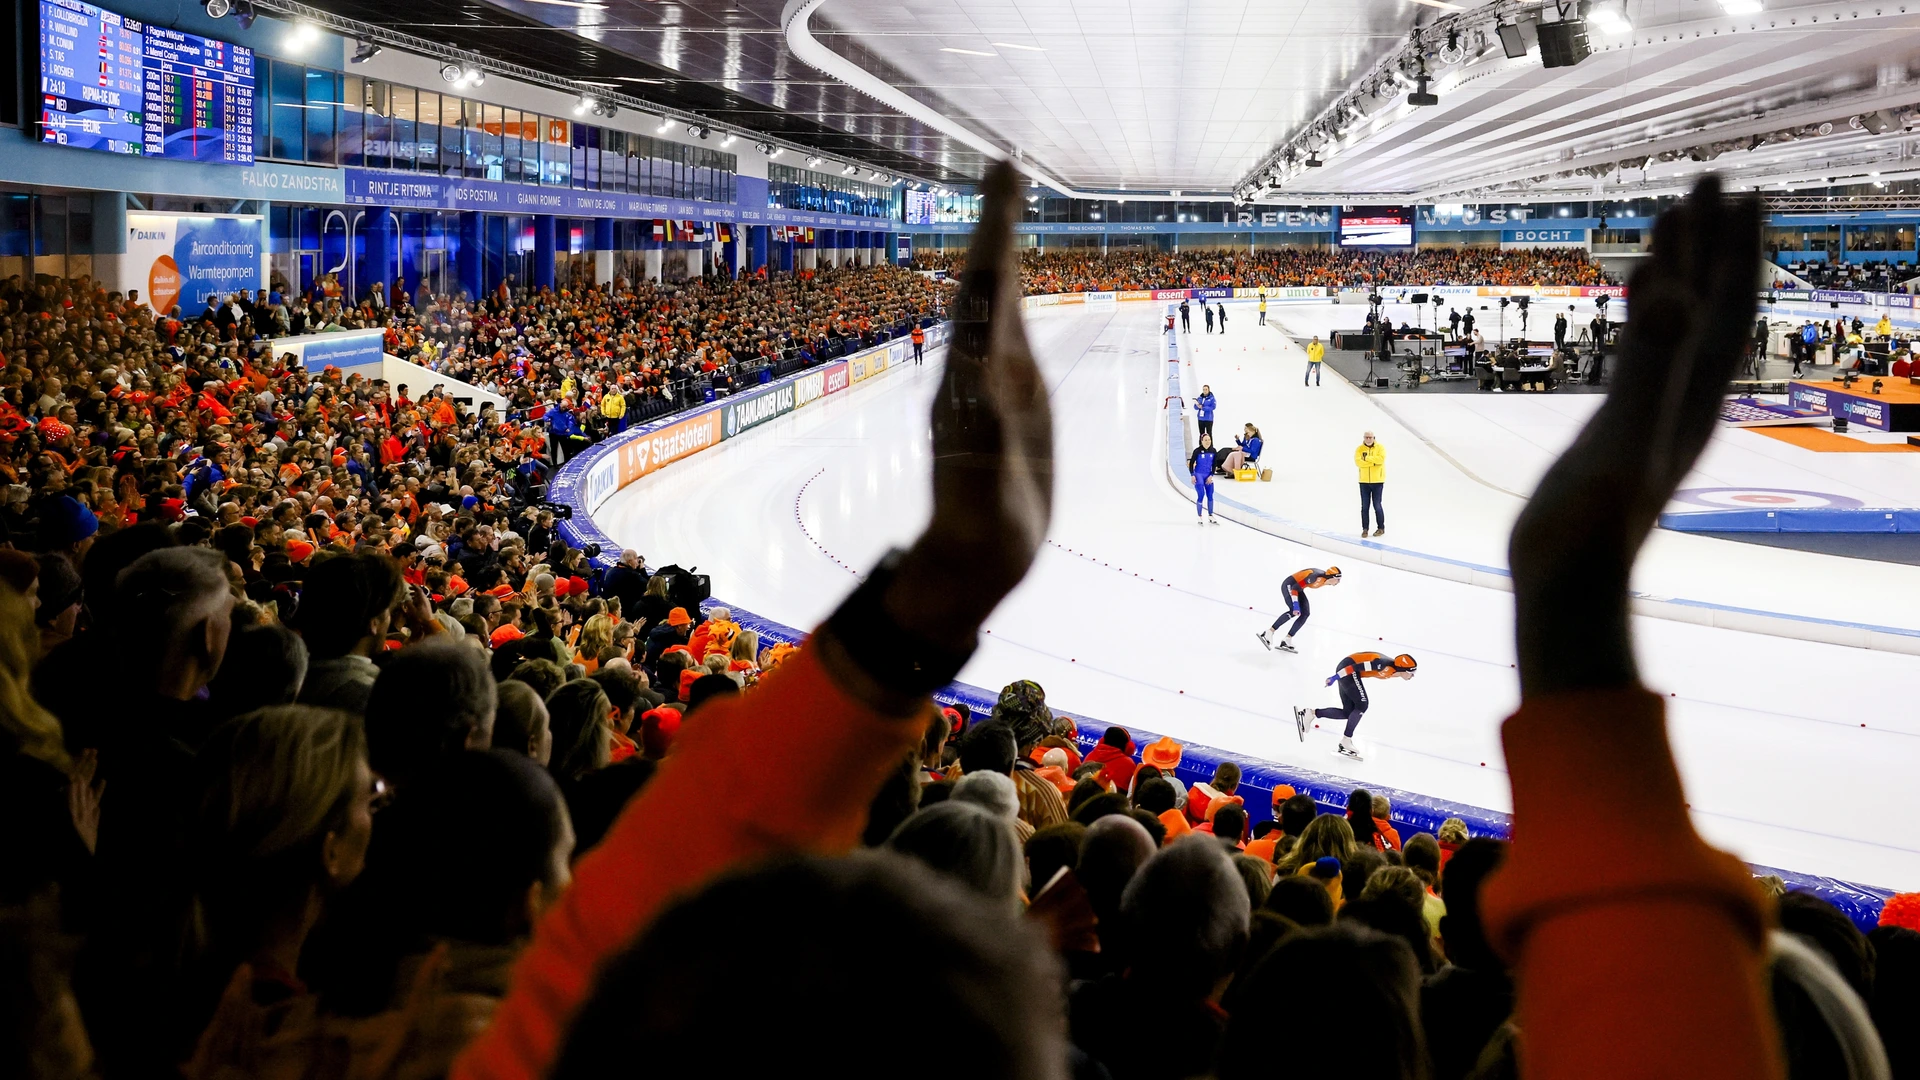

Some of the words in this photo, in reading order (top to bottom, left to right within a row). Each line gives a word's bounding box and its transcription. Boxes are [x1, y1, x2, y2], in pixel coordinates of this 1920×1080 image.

[149, 26, 165, 38] Ragne
[204, 39, 215, 48] NOR
[149, 37, 174, 50] Francesca
[204, 49, 212, 57] ITA
[54, 50, 65, 62] TAS
[204, 59, 215, 68] NED
[146, 71, 160, 81] 200m
[164, 74, 174, 83] 19.7
[146, 81, 160, 91] 600m
[164, 85, 174, 94] 30.0
[196, 90, 205, 98] 30.2
[56, 98, 67, 111] NED
[145, 92, 161, 101] 1000m
[164, 95, 174, 104] 30.4
[145, 102, 161, 112] 1400m
[164, 105, 174, 114] 31.4
[145, 123, 161, 132] 2200m
[164, 115, 174, 124] 31.9
[196, 120, 206, 128] 31.5
[56, 132, 67, 145] NED
[145, 144, 161, 153] 3000m
[242, 171, 278, 189] FALKO
[281, 174, 338, 192] ZANDSTRA
[369, 181, 398, 196] RINTJE
[401, 184, 432, 198] RITSMA
[469, 189, 498, 203] POSTMA
[517, 193, 539, 205] GIANNI
[540, 195, 561, 207] ROMME
[577, 198, 594, 209] TONNY
[595, 199, 602, 209] DE
[603, 200, 616, 210] JONG
[628, 201, 651, 212] MARIANNE
[652, 203, 668, 213] TIMMER
[686, 206, 694, 215] BOS
[1223, 211, 1329, 228] IREEN
[137, 231, 166, 240] DAIKIN
[1515, 230, 1571, 241] BOCHT
[191, 241, 254, 258] Airconditioning
[188, 265, 254, 282] Warmtepompen
[1157, 290, 1185, 299] essent
[1588, 287, 1623, 296] essent
[1779, 291, 1809, 300] ZAANLANDER
[1819, 293, 1836, 302] Holland
[1836, 294, 1853, 303] America
[828, 366, 847, 393] essent
[794, 374, 824, 408] JUMBO
[736, 391, 776, 434] ZAANLANDER
[776, 385, 793, 412] KAAS
[652, 414, 713, 464] Staatsloterij
[594, 463, 615, 502] DAIKIN
